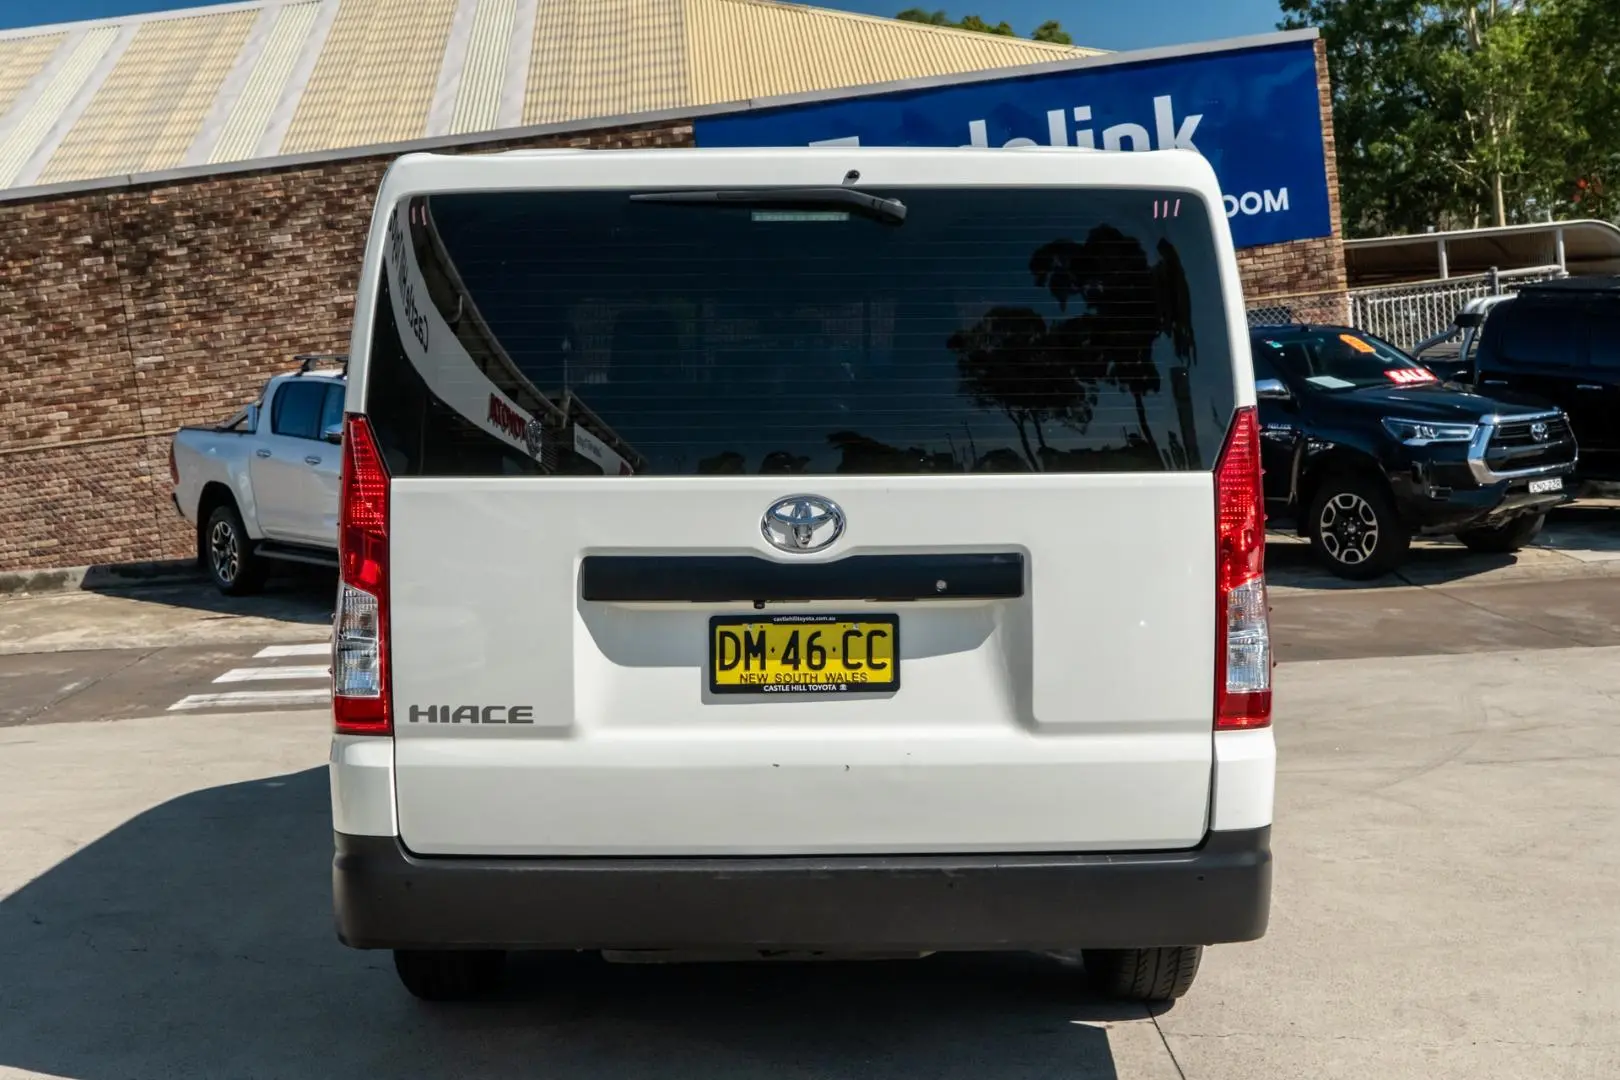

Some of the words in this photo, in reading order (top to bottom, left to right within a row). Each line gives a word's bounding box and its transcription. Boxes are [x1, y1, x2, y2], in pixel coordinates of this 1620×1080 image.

[739, 673, 768, 684] NEW
[775, 672, 818, 683] SOUTH
[825, 671, 868, 683] WALES
[763, 684, 790, 692] CASTLE
[791, 684, 807, 692] HILL
[808, 683, 837, 691] TOYOTA
[408, 704, 534, 724] HIACE
